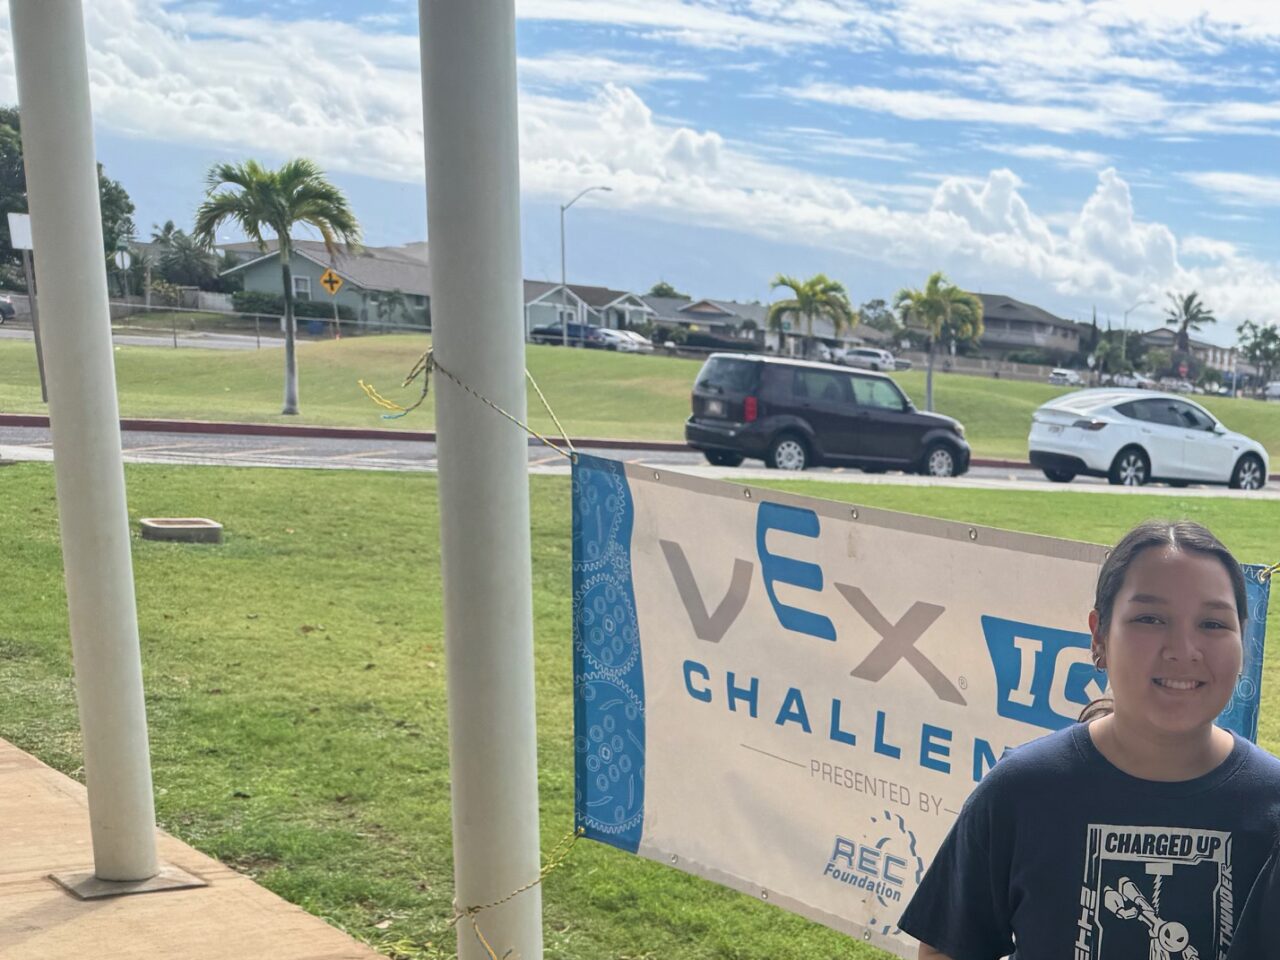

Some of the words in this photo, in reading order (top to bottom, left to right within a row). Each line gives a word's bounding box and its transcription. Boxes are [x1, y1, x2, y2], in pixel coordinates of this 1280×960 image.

[1007, 636, 1107, 722] IQ
[683, 659, 1014, 783] CHALLEN
[811, 760, 910, 806] PRESENTED
[919, 792, 943, 816] BY
[830, 835, 908, 887] REC
[1104, 832, 1193, 857] CHARGED
[1196, 835, 1221, 859] UP
[823, 862, 902, 902] Foundation
[1218, 864, 1233, 947] THUNDER
